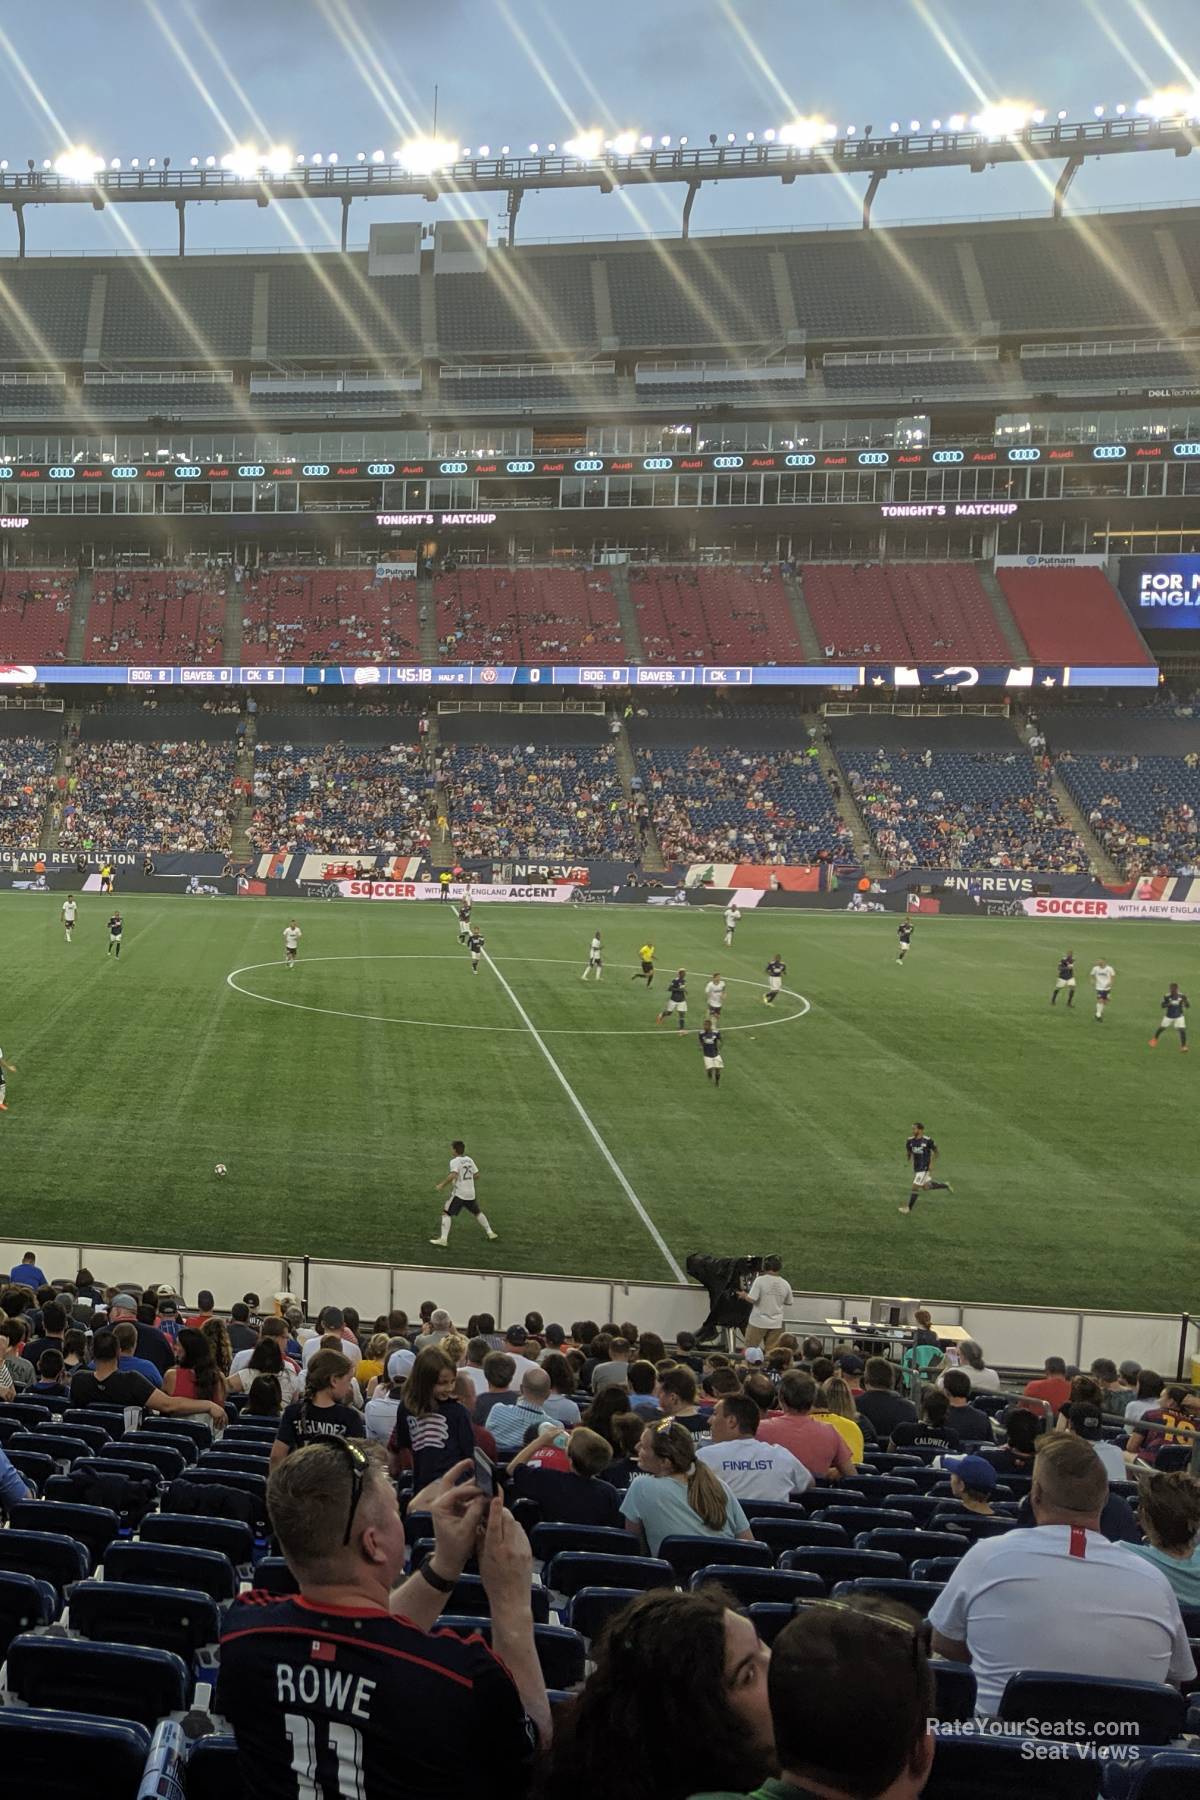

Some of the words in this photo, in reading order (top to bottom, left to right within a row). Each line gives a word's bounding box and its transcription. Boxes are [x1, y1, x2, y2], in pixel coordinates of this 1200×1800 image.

[973, 452, 996, 461] Audi
[1049, 450, 1073, 459] Audi
[1136, 448, 1161, 456] Audi
[681, 460, 703, 468] Audi
[752, 458, 774, 466] Audi
[824, 456, 846, 465] Audi
[898, 455, 920, 463] Audi
[337, 466, 358, 474] Audi
[403, 466, 423, 474] Audi
[476, 464, 496, 472] Audi
[543, 463, 564, 472] Audi
[612, 462, 632, 470] Audi
[20, 470, 40, 478] Audi
[82, 470, 102, 478] Audi
[146, 469, 165, 477] Audi
[209, 468, 228, 476] Audi
[272, 467, 292, 476] Audi
[882, 505, 946, 517] TONIGHT'S
[956, 504, 1017, 516] MATCHUP
[376, 514, 434, 525] TONIGHT'S
[442, 514, 496, 524] MATCHUP
[1038, 556, 1076, 565] Putnam
[385, 568, 414, 576] Putnam
[1141, 574, 1183, 590] FOR
[132, 671, 153, 681] SOG:
[159, 671, 166, 681] 2
[183, 671, 215, 681] SAVES:
[221, 671, 228, 681] 0
[247, 671, 262, 681] CK:
[319, 669, 326, 682] 1
[397, 668, 432, 681] 45:18
[530, 669, 540, 682] 0
[584, 671, 607, 681] SOG:
[612, 671, 620, 681] 0
[640, 671, 676, 681] SAVES:
[681, 671, 686, 681] 1
[710, 671, 727, 681] CK:
[736, 671, 741, 681] 1
[944, 876, 1032, 892] #NREVS
[350, 882, 416, 897] SOCCER
[471, 888, 506, 896] ENGLAND
[509, 888, 556, 898] ACCENT
[1036, 900, 1108, 915] SOCCER
[1162, 1414, 1196, 1444] 10
[914, 1436, 950, 1449] CALDWELL
[722, 1460, 774, 1471] FINALIST
[276, 1664, 376, 1720] ROWE
[285, 1713, 367, 1800] 11
